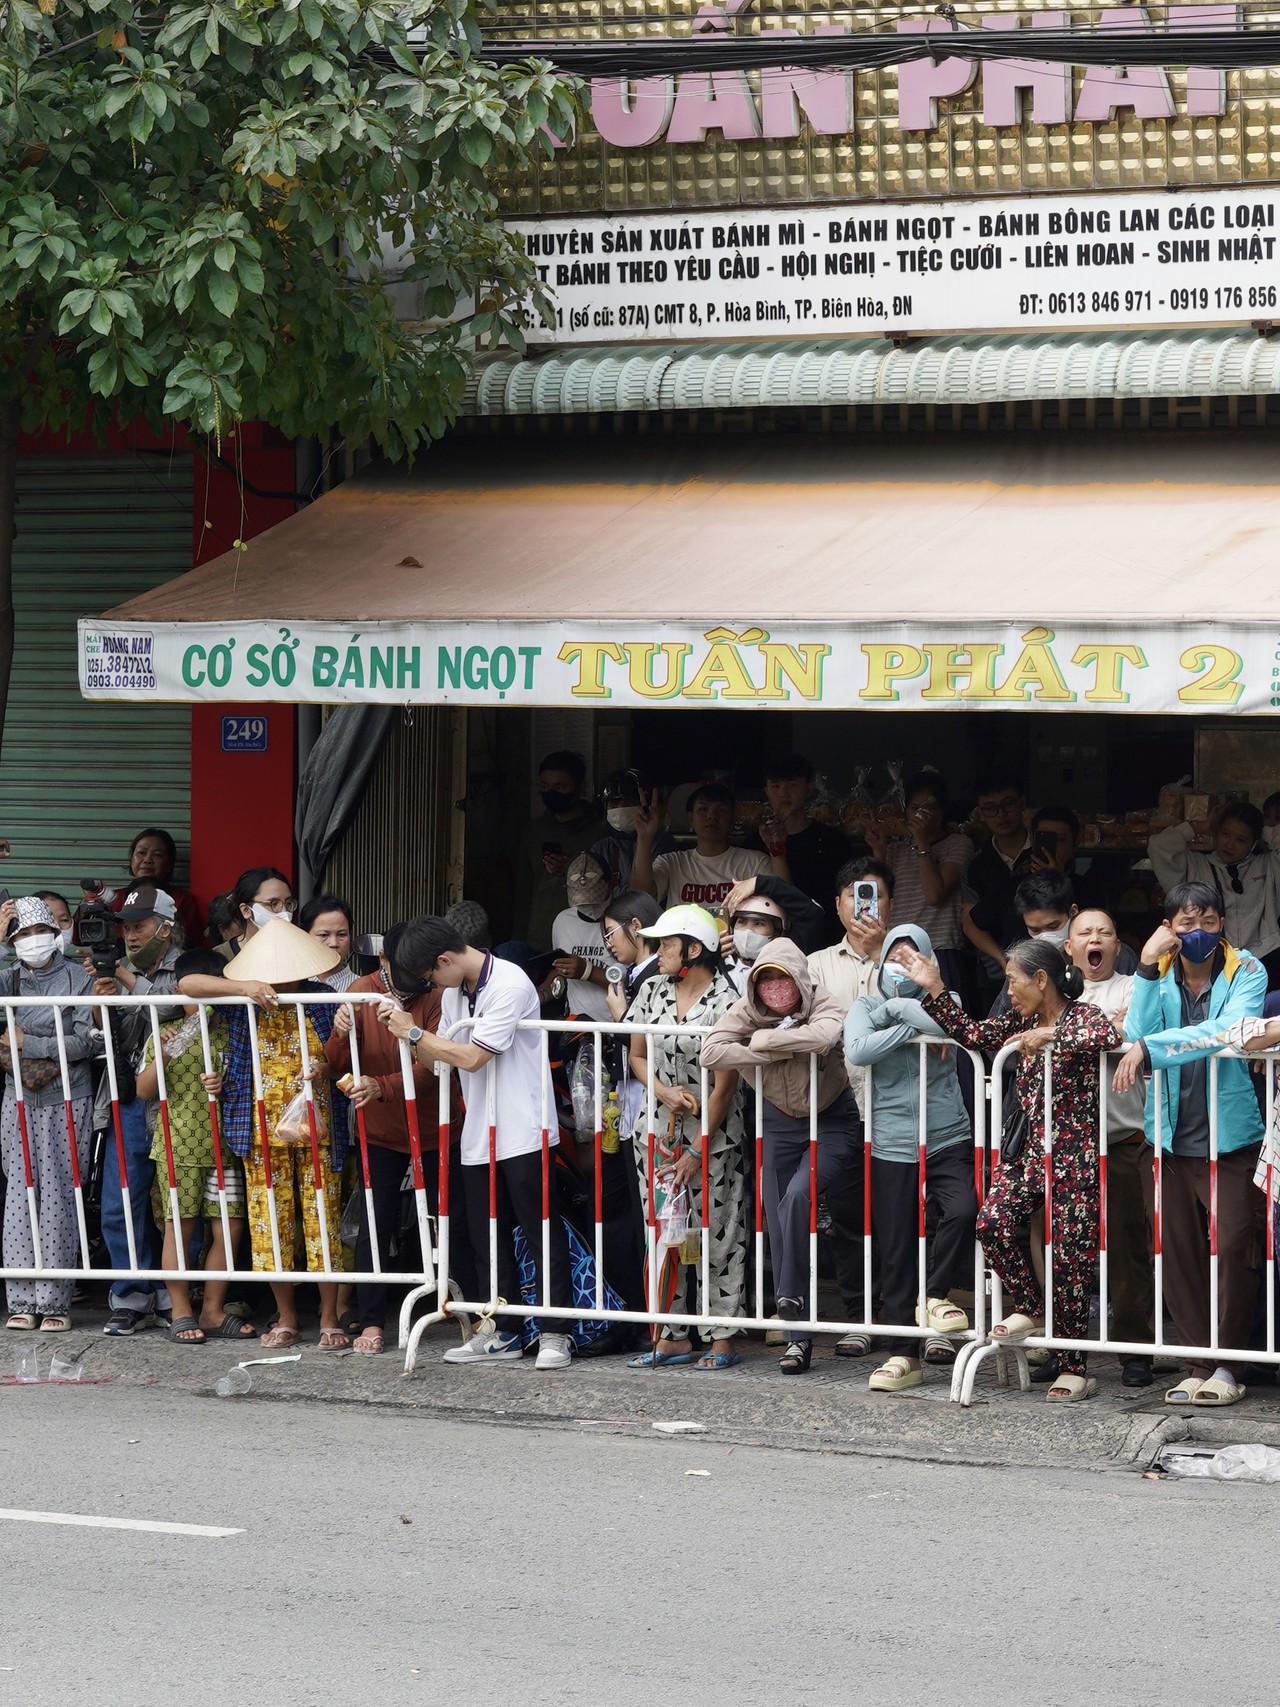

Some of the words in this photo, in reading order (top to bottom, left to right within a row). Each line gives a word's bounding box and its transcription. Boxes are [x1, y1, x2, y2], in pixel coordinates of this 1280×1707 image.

[524, 229, 594, 256] HUYÊN
[601, 225, 642, 253] SẢN
[712, 222, 770, 248] BÁNH
[778, 219, 805, 245] MÌ
[828, 217, 888, 243] BÁNH
[896, 216, 956, 243] NGỌT
[979, 211, 1039, 237] BÁNH
[1049, 208, 1110, 235] BÔNG
[1119, 208, 1159, 232] LAN
[1168, 203, 1215, 231] CÁC
[1224, 204, 1275, 232] LOẠI
[556, 260, 610, 286] BÁNH
[617, 260, 667, 283] THEO
[674, 255, 711, 281] YÊU
[718, 249, 760, 280] CẦU
[781, 251, 817, 281] HỘI
[825, 252, 875, 278] NGHỊ
[897, 245, 943, 276] TIỆC
[950, 243, 1002, 271] CƯỚI
[1025, 241, 1068, 268] LIÊN
[1076, 242, 1135, 266] HOAN
[1157, 239, 1210, 264] SINH
[1218, 233, 1277, 264] NHẬT
[570, 303, 589, 331] (số
[594, 306, 614, 326] cũ:
[619, 305, 649, 329] 87A)
[654, 303, 685, 325] CMT
[689, 303, 702, 327] 8,
[707, 303, 720, 323] P.
[725, 302, 751, 322] Hòa
[756, 300, 790, 323] Bình,
[795, 299, 816, 320] TP.
[822, 297, 851, 319] Biên
[857, 297, 888, 320] Hòa,
[892, 295, 912, 316] ĐN
[1019, 294, 1043, 315] ĐT:
[1049, 291, 1086, 314] 0613
[1092, 290, 1119, 312] 846
[1125, 290, 1151, 311] 971
[1170, 287, 1208, 310] 0919
[1215, 286, 1242, 309] 176
[1248, 285, 1277, 308] 856
[132, 637, 152, 654] NAM
[181, 637, 235, 688] CƠ
[246, 627, 300, 688] SỞ
[312, 634, 421, 690] BÁNH
[437, 645, 542, 699] NGỌT
[557, 626, 832, 701] TUẤN
[858, 626, 1150, 704] PHÁT
[1177, 643, 1247, 705] 2
[87, 675, 155, 688] 0903.004490
[226, 719, 264, 740] 249
[681, 882, 734, 904] GUCC
[571, 946, 604, 956] CHANGE
